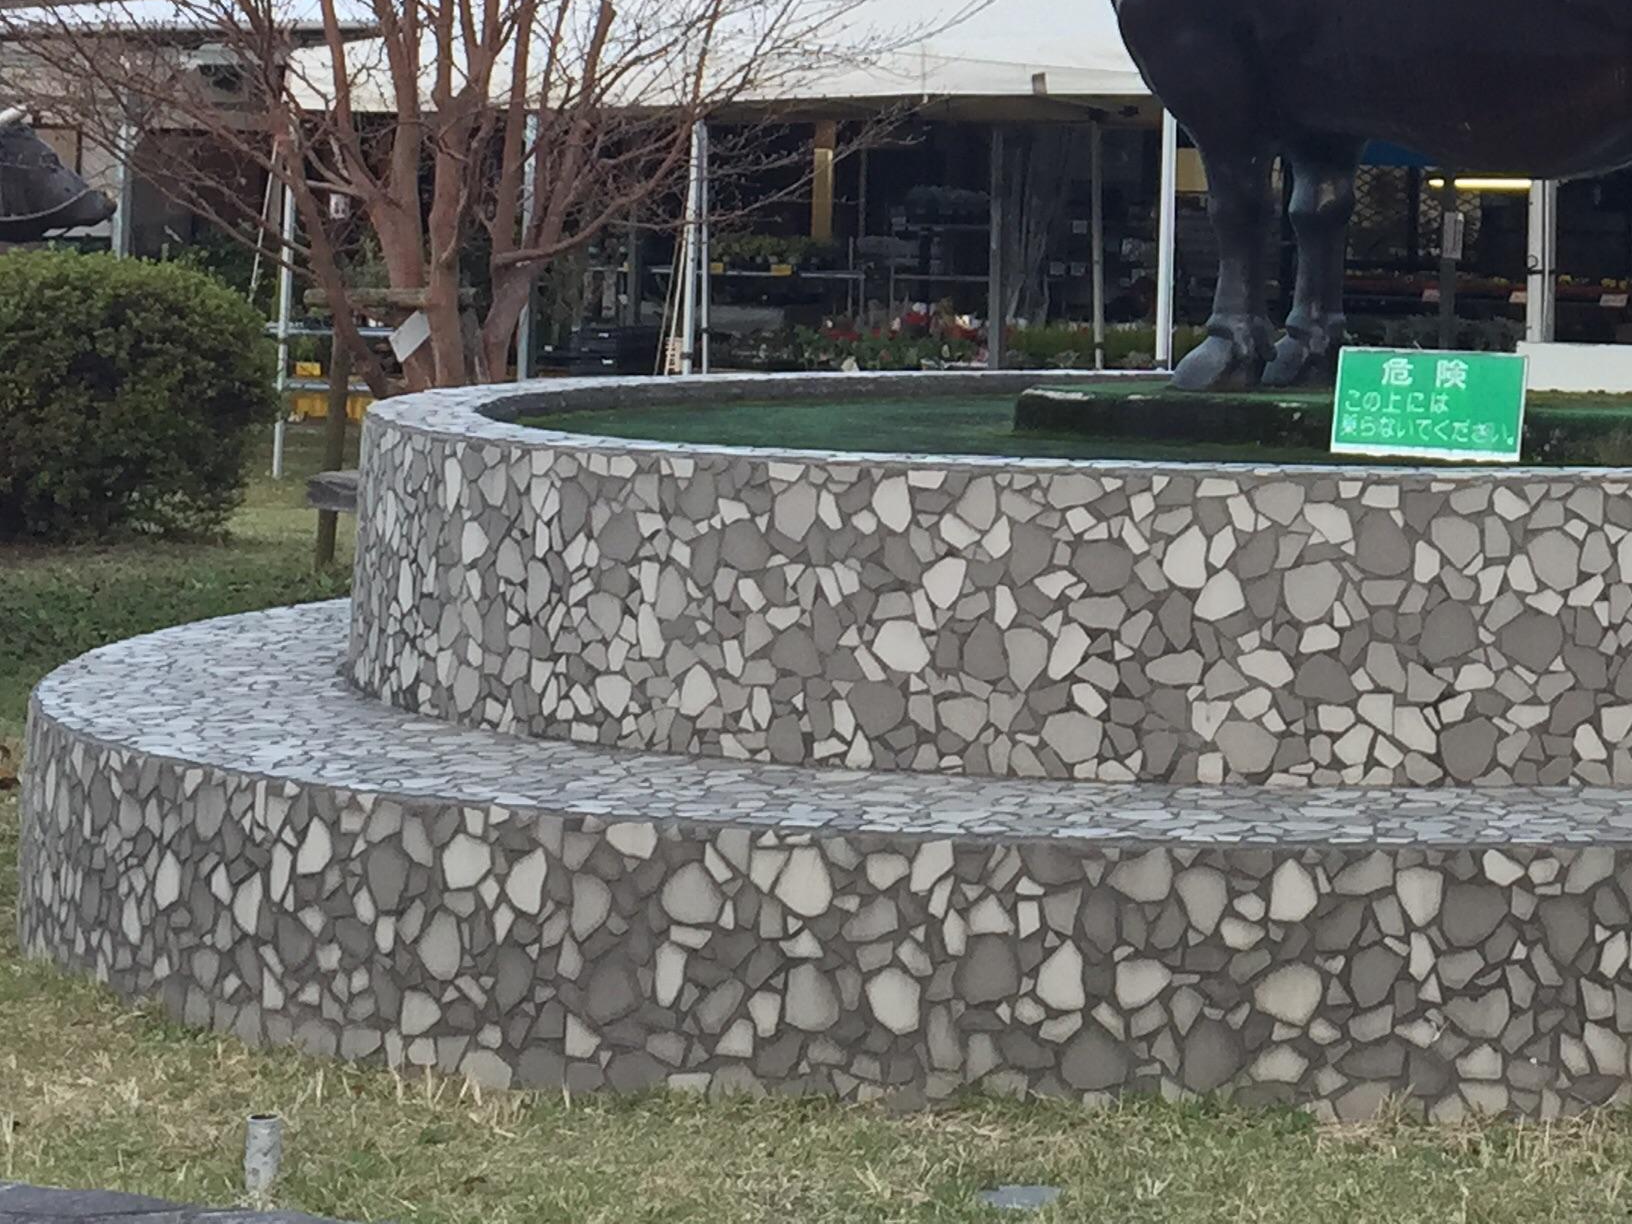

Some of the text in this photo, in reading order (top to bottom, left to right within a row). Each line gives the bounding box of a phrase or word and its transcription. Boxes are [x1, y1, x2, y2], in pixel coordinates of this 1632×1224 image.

[1381, 358, 1469, 389] 危険
[1345, 390, 1450, 414] この上には
